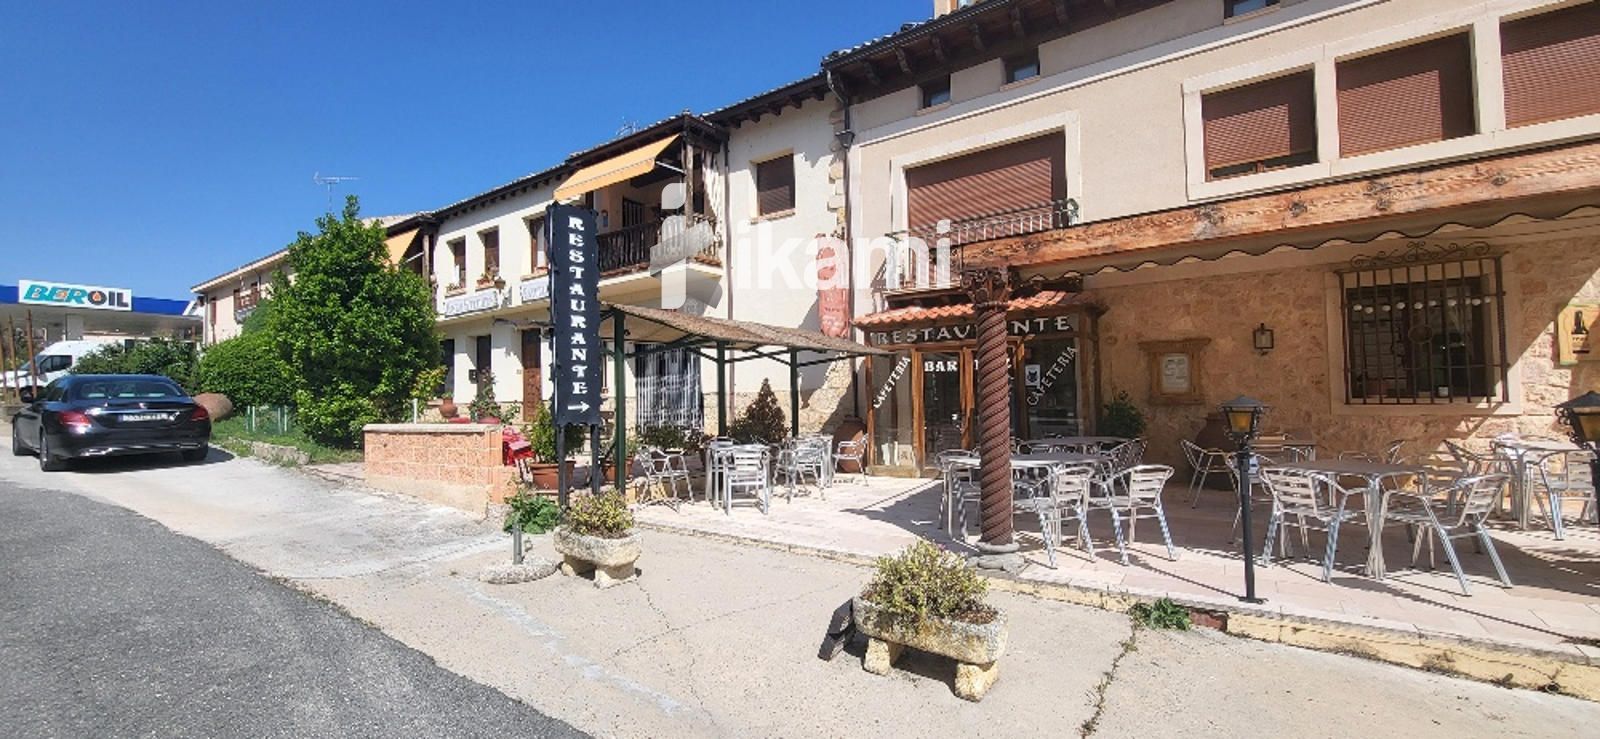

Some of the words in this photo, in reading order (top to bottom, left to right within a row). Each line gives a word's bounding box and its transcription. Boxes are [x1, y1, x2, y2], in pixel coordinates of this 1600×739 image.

[24, 284, 129, 307] BEROIL
[567, 216, 588, 395] RESTAURANTE
[876, 315, 1070, 345] RESTAUNTE
[873, 356, 911, 409] CAFETERIA
[924, 360, 958, 372] BAR
[1026, 346, 1078, 406] CAFETERIA
